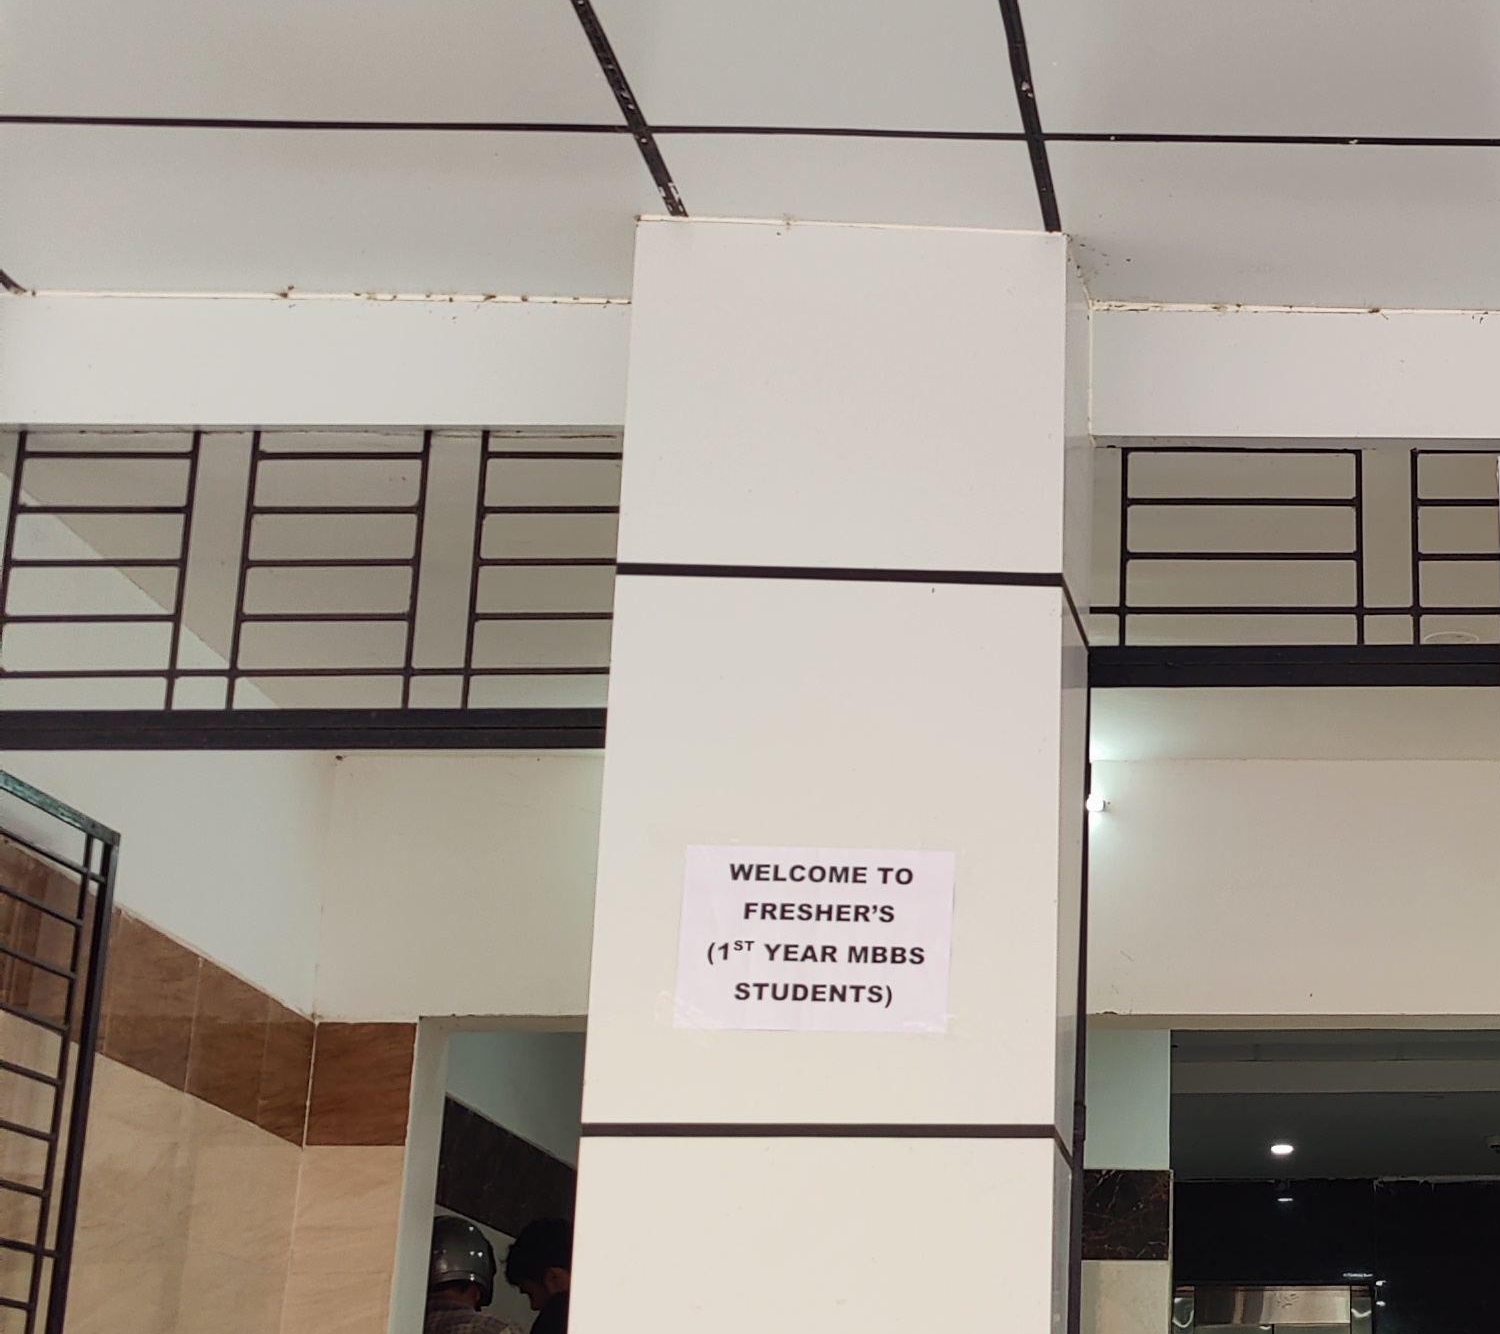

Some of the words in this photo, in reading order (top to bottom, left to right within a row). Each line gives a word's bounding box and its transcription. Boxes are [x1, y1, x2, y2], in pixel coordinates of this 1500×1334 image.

[729, 863, 868, 884] WELCOME
[877, 867, 914, 886] TO
[743, 902, 895, 923] FRESHER’S
[706, 939, 755, 966] (1ST
[764, 943, 838, 964] YEAR
[847, 945, 925, 966] MBBS
[734, 982, 893, 1009] STUDENTS)
